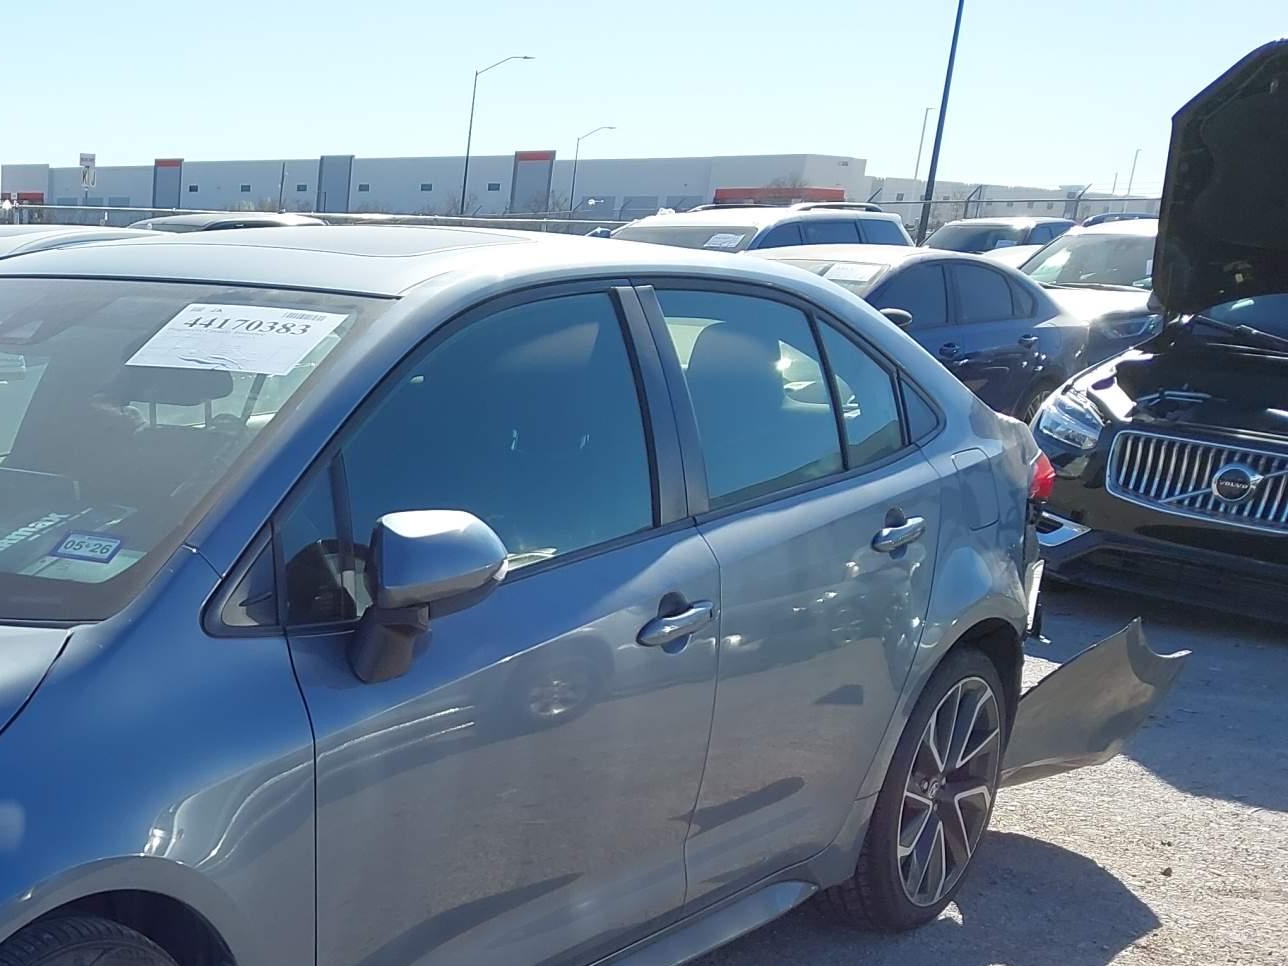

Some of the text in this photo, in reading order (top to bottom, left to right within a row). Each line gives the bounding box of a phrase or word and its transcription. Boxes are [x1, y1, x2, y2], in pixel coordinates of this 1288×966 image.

[183, 315, 312, 336] 44170383
[1219, 480, 1249, 489] VOLVO
[63, 540, 113, 555] 05 26
